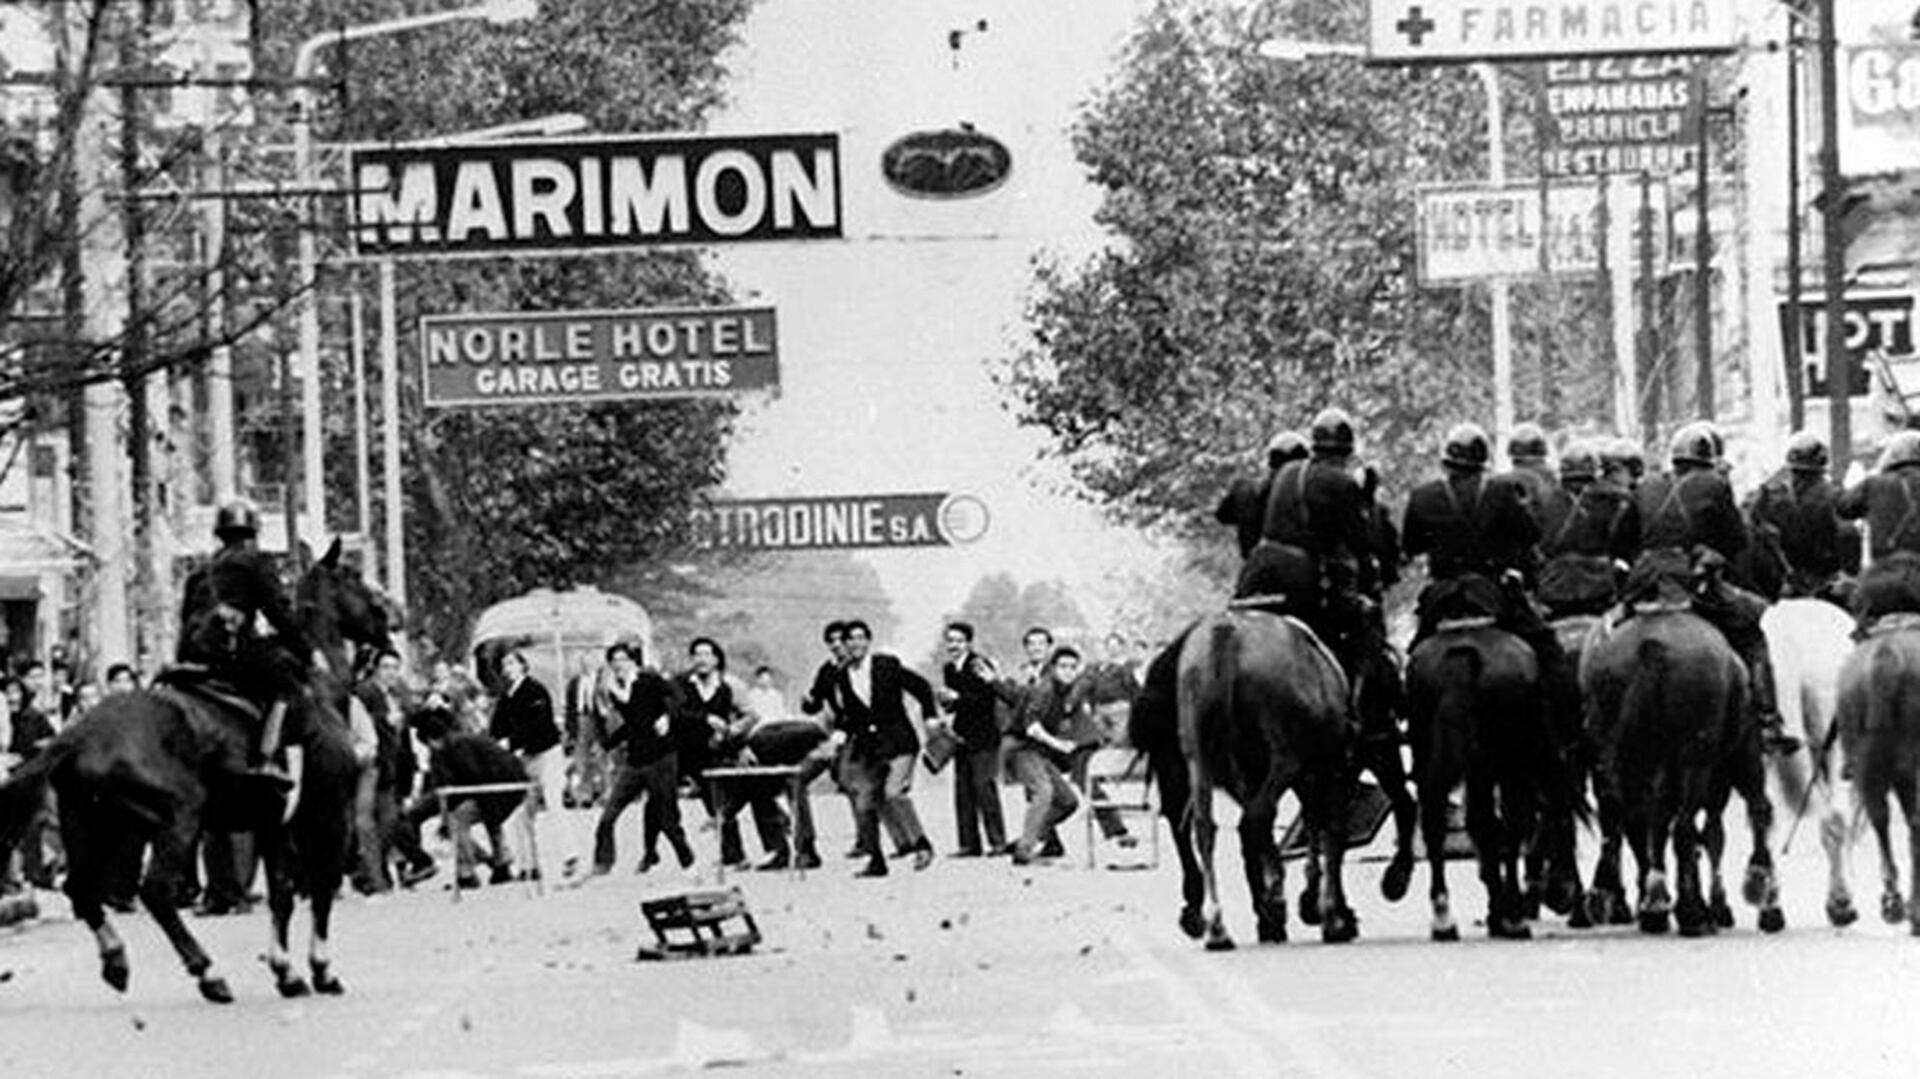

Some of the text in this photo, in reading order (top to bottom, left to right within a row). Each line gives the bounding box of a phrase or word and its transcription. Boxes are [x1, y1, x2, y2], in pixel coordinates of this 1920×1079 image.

[1460, 0, 1709, 42] FARMACIA
[1547, 81, 1688, 114] EMPANADAS
[358, 148, 837, 244] MARIMON
[1430, 198, 1534, 251] HOTEL
[429, 318, 772, 364] NORLE HOTEL
[475, 360, 733, 395] GARAGE GRATIS
